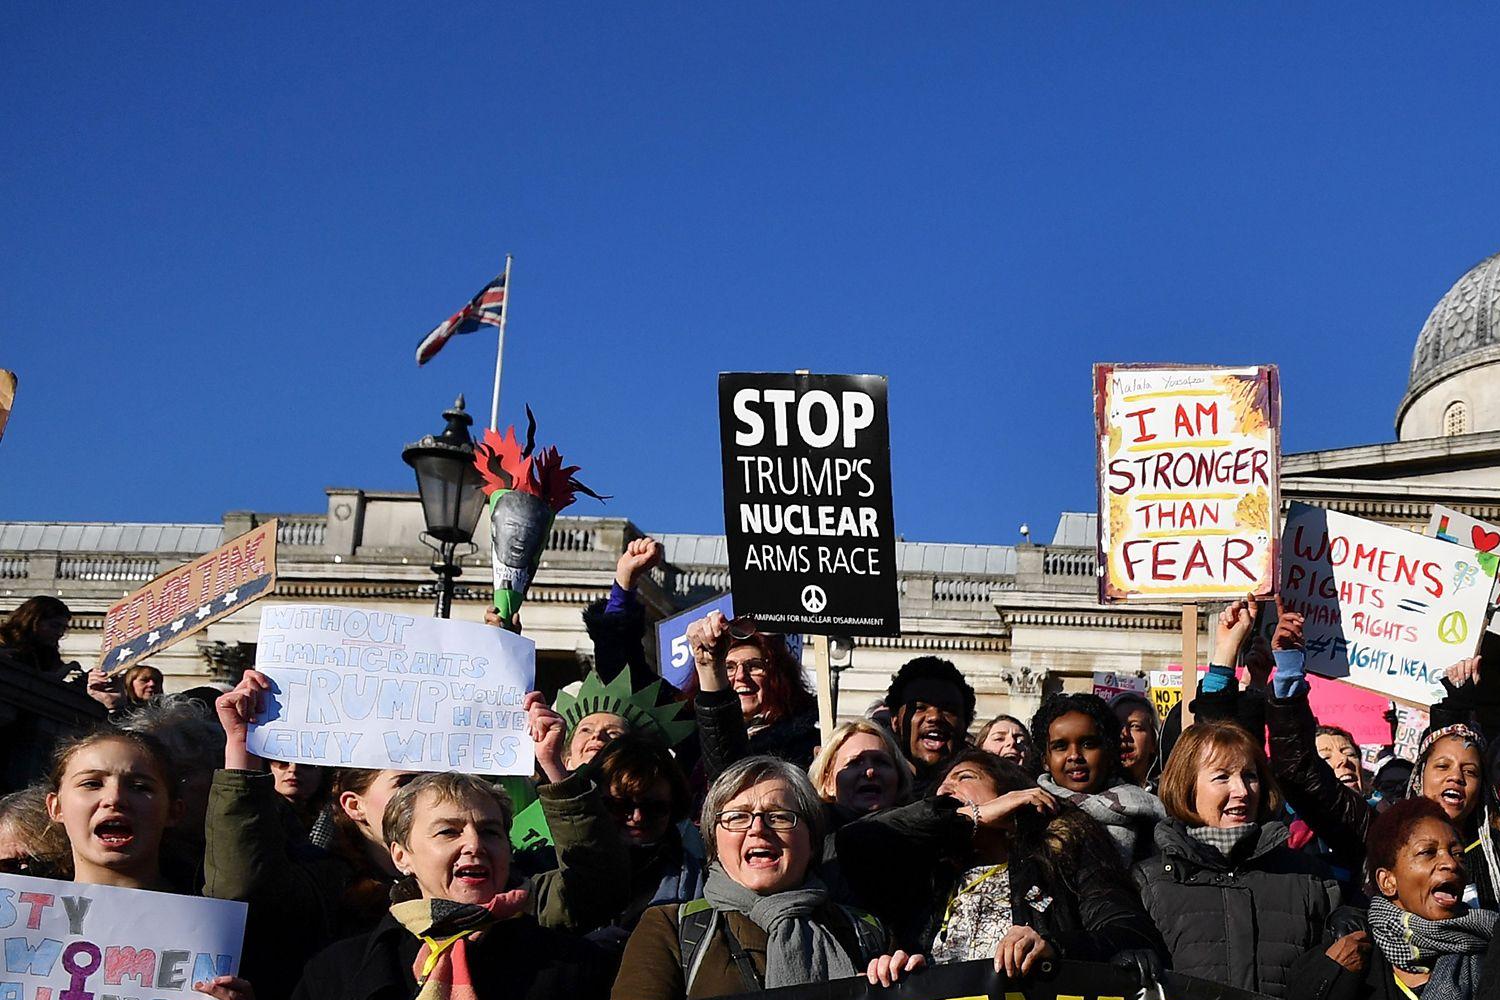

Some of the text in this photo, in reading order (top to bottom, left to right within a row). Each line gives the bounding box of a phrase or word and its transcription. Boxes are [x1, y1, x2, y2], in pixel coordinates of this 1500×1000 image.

[1112, 377, 1153, 395] Malala
[733, 388, 875, 448] STOP
[1175, 401, 1218, 438] AM
[737, 456, 875, 497] TRUMP'S
[1108, 447, 1269, 495] STRONGER
[739, 504, 880, 538] NUCLEAR
[1135, 501, 1219, 529] THAN
[745, 544, 881, 576] ARMS RACE
[1295, 525, 1444, 598] WOMENS
[104, 532, 266, 652] REVOLTING
[1286, 564, 1385, 608] RIGHTS
[265, 607, 414, 643] WITHOUT
[752, 613, 884, 626] AMPAIGN FOR NUCLEAR DISARMAMENT
[1352, 611, 1418, 643] RIGHTS
[263, 668, 449, 725] TRUMP
[1155, 690, 1170, 703] NO
[1157, 704, 1174, 716] RA
[453, 706, 525, 731] HAVE
[263, 728, 521, 769] ANY WIFES
[4, 936, 232, 1000] WOMEN
